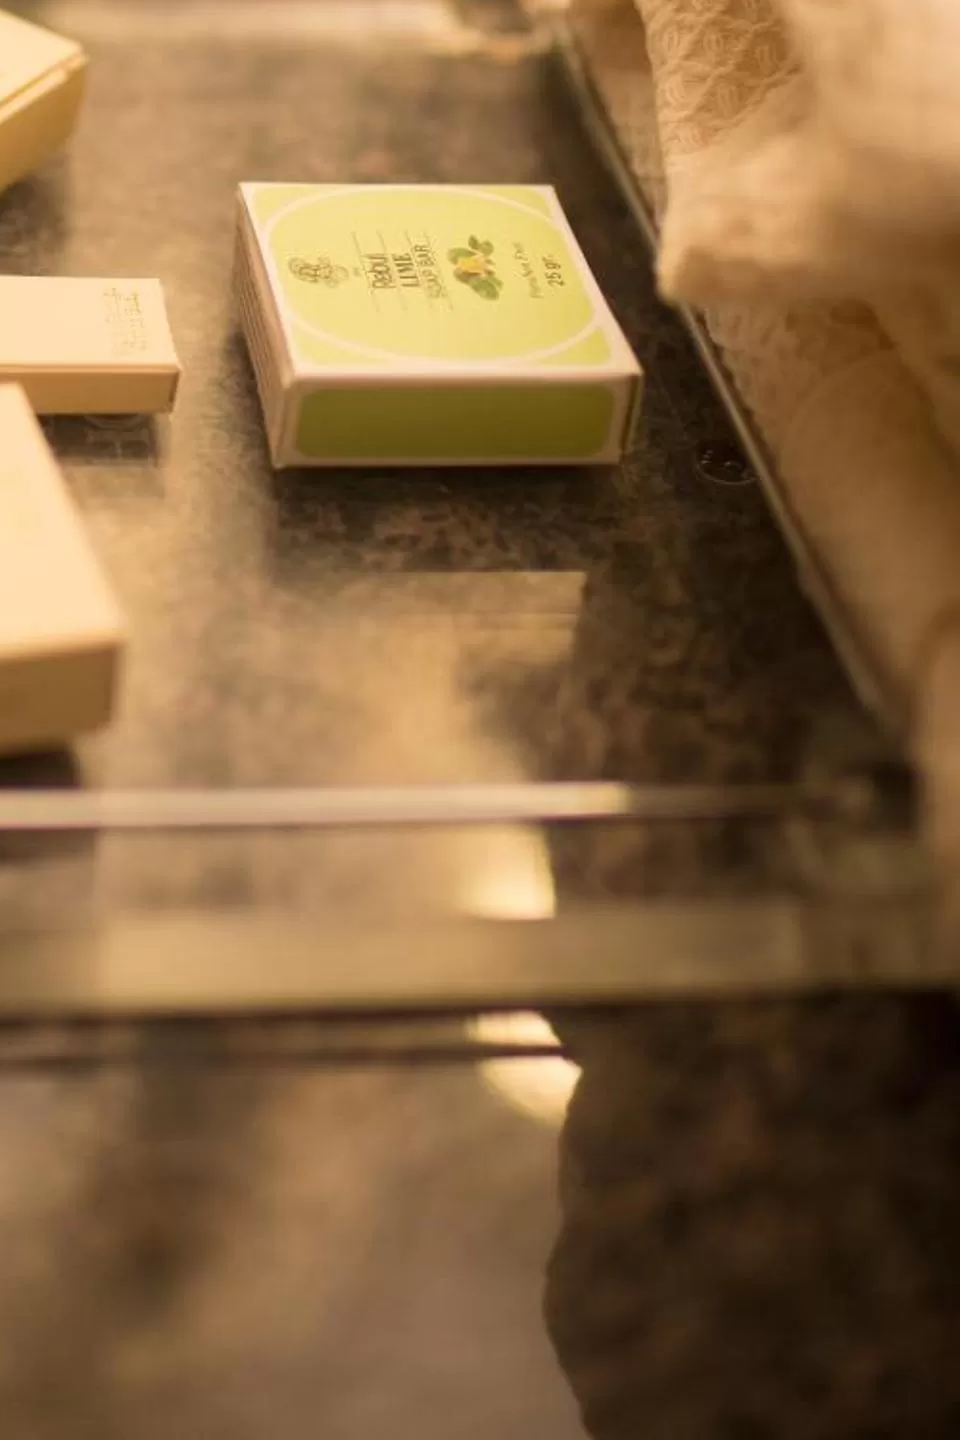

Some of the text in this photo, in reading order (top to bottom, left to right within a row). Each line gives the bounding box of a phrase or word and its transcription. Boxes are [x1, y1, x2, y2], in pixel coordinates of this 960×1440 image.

[414, 244, 434, 266] BAR
[393, 252, 418, 287] LIME
[548, 272, 565, 286] 25
